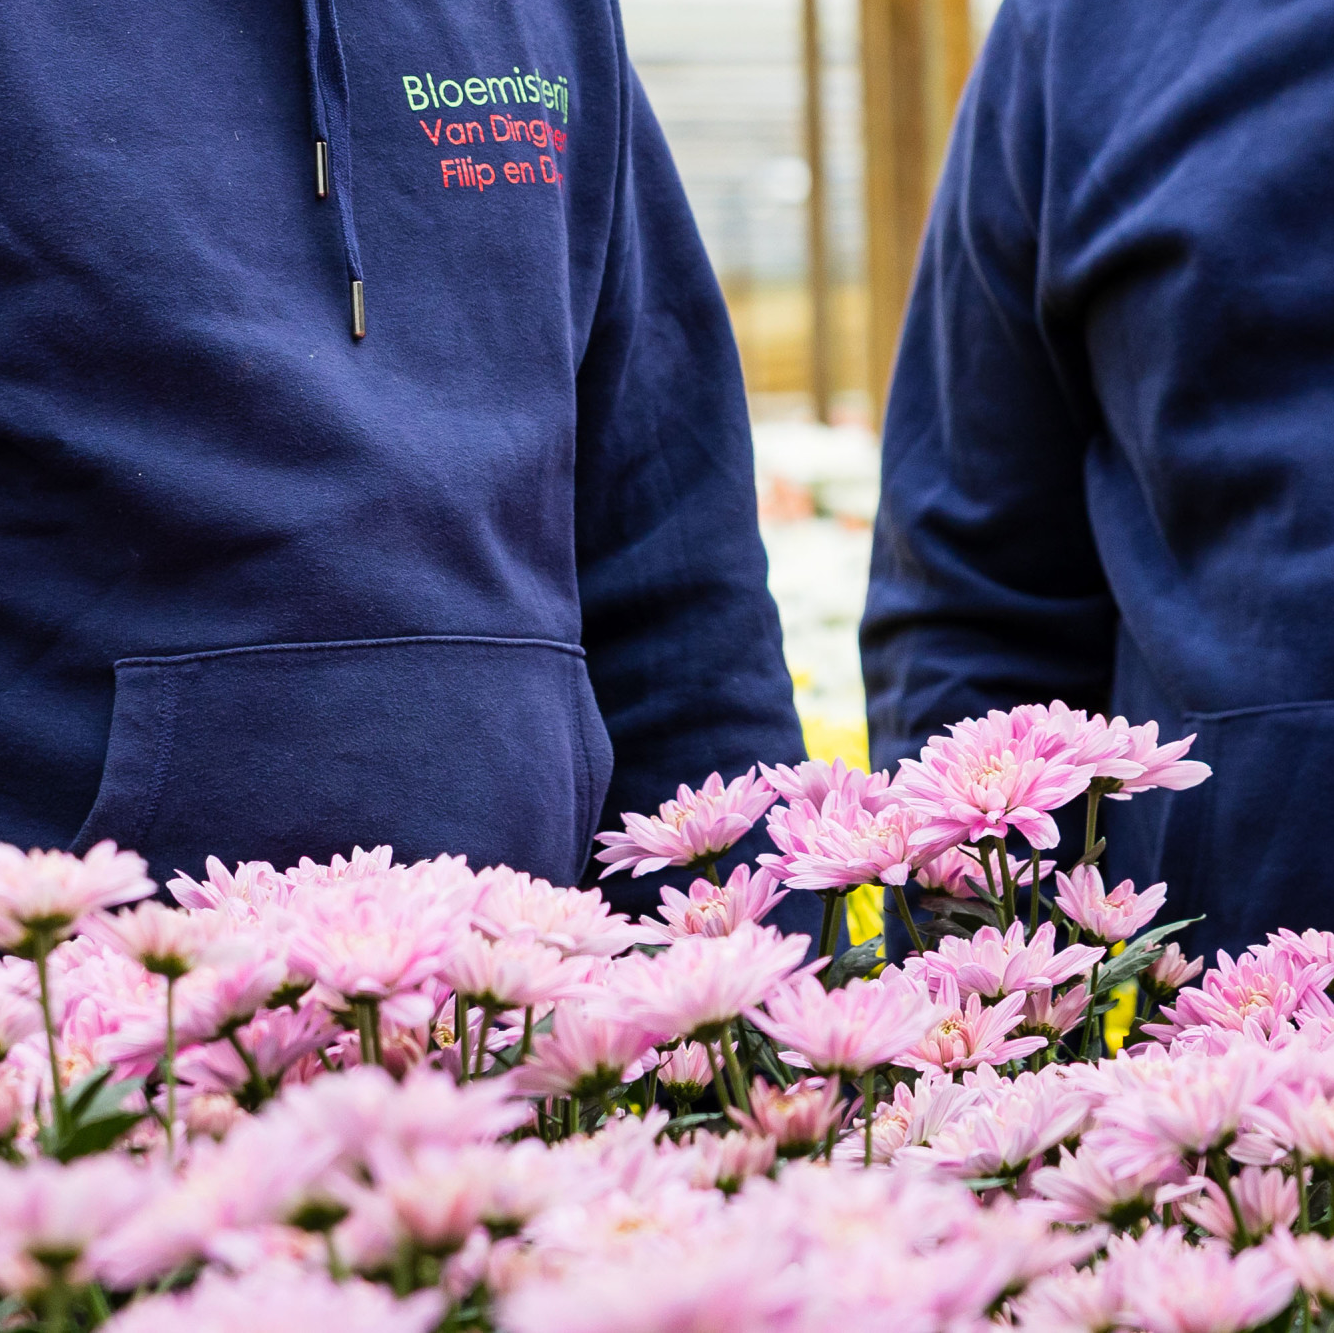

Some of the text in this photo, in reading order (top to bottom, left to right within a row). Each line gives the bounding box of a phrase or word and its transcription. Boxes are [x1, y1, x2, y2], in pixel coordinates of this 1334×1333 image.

[419, 118, 485, 146] Van
[440, 157, 496, 192] Filip
[503, 159, 536, 184] en
